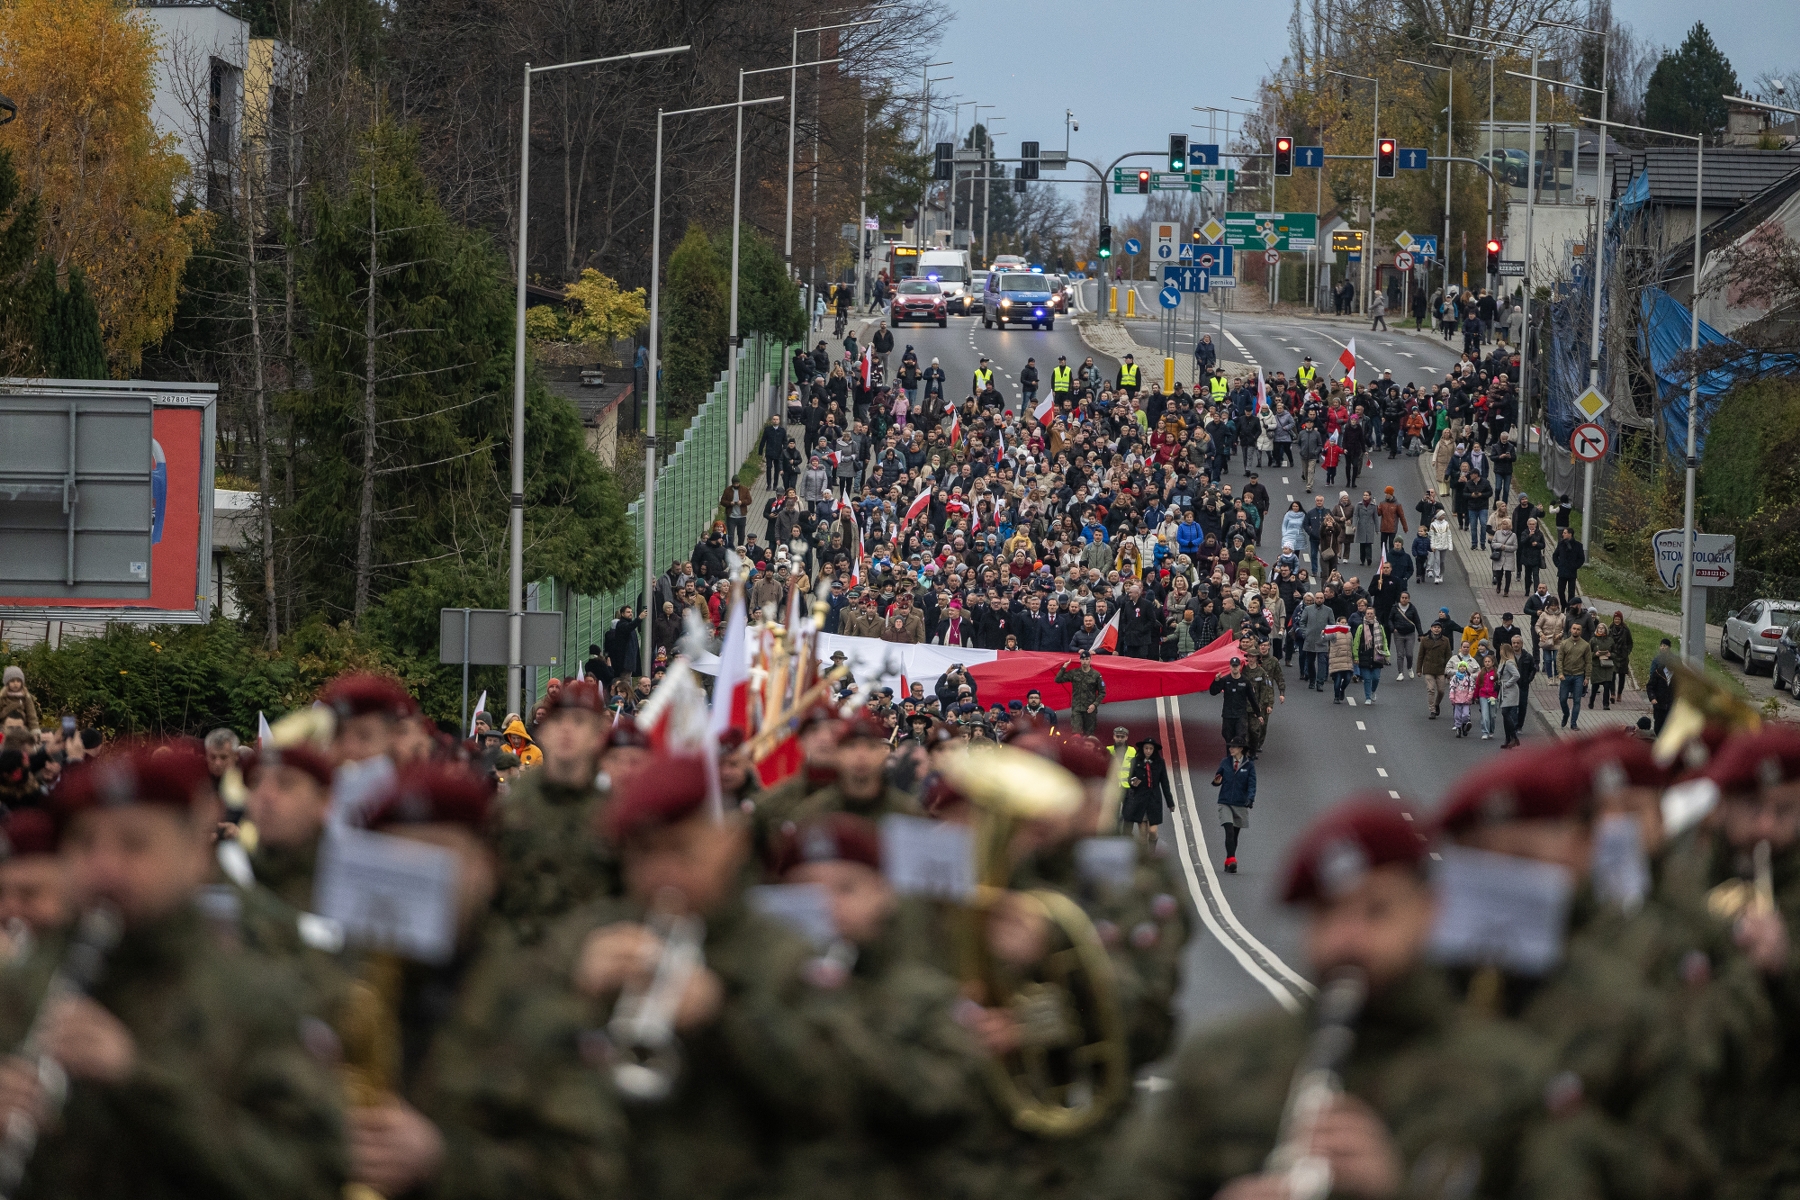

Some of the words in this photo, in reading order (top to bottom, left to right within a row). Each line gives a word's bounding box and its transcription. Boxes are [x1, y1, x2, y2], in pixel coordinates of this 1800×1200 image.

[1209, 278, 1234, 286] pernika
[162, 395, 189, 403] 267801
[1661, 550, 1731, 563] STOMTOLOGIA
